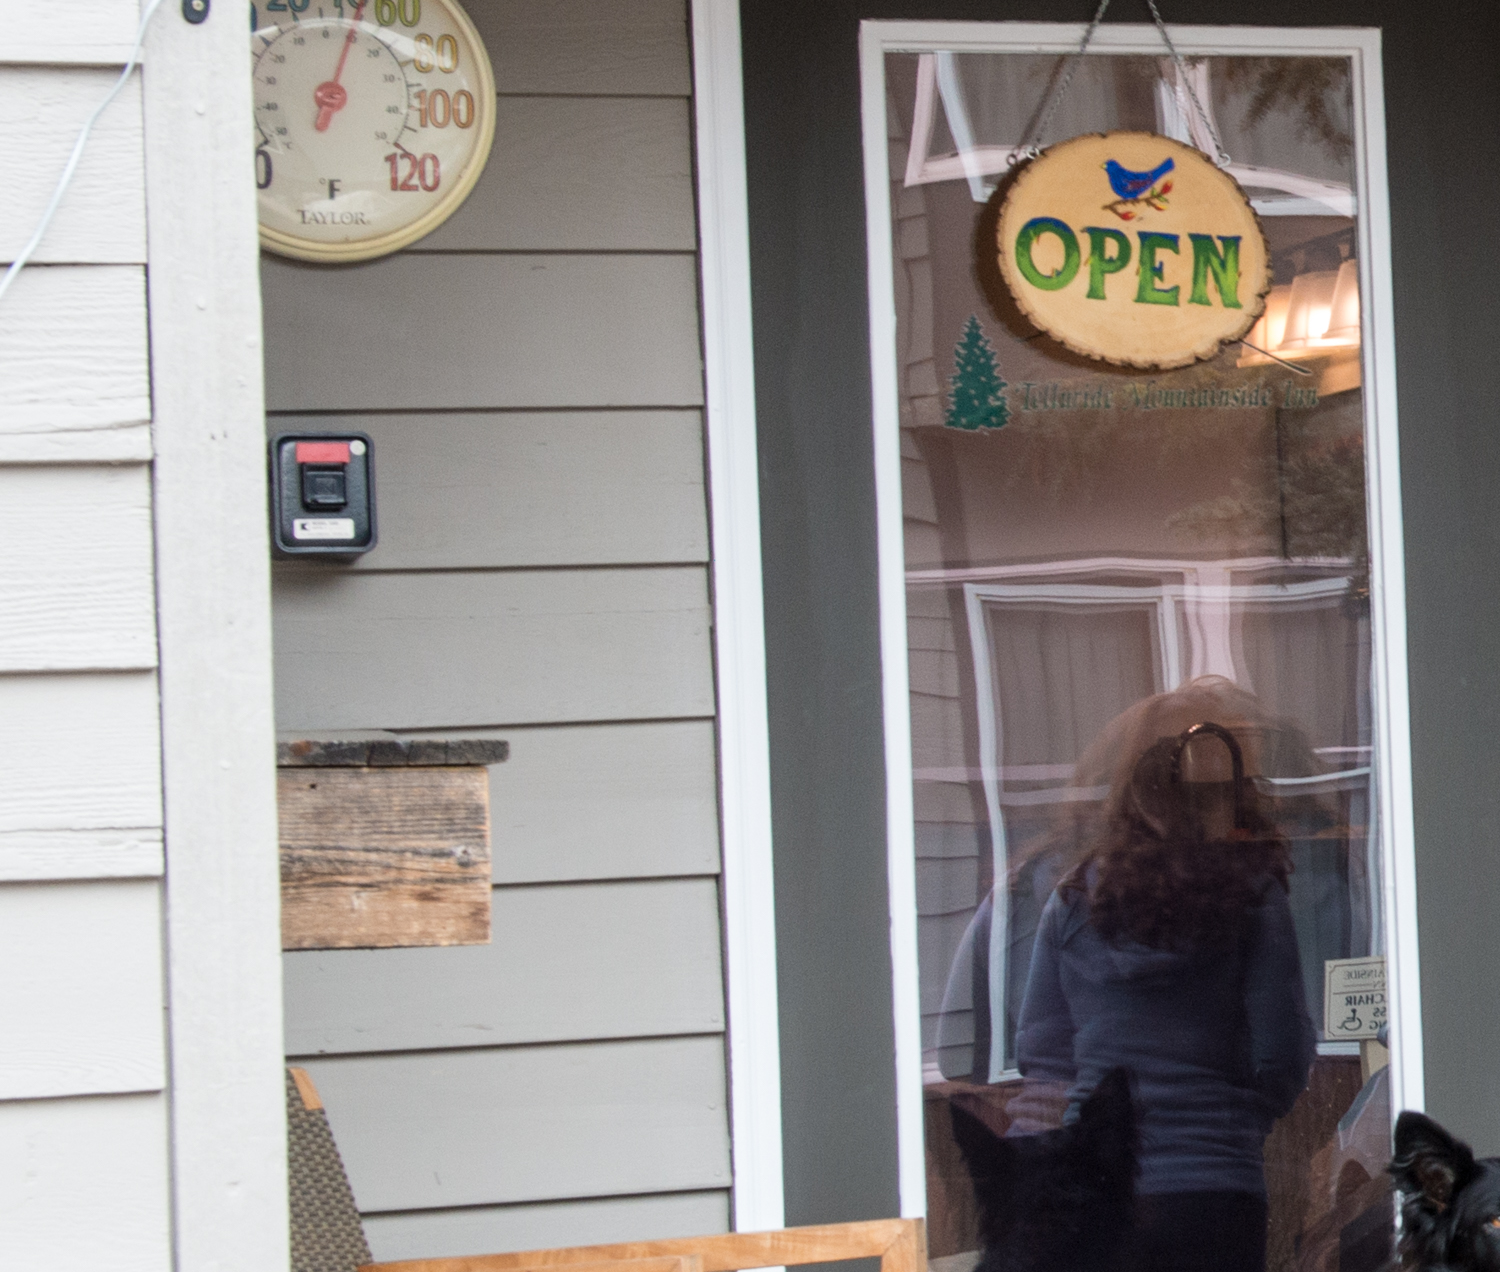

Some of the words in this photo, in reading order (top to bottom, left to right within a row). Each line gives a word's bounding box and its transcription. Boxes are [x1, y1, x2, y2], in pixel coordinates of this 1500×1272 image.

[414, 33, 459, 74] 80
[413, 89, 475, 129] 100
[384, 153, 440, 192] 120
[1015, 217, 1243, 309] OPEN
[1020, 382, 1112, 411] Telluride
[1122, 379, 1272, 409] Mountainside
